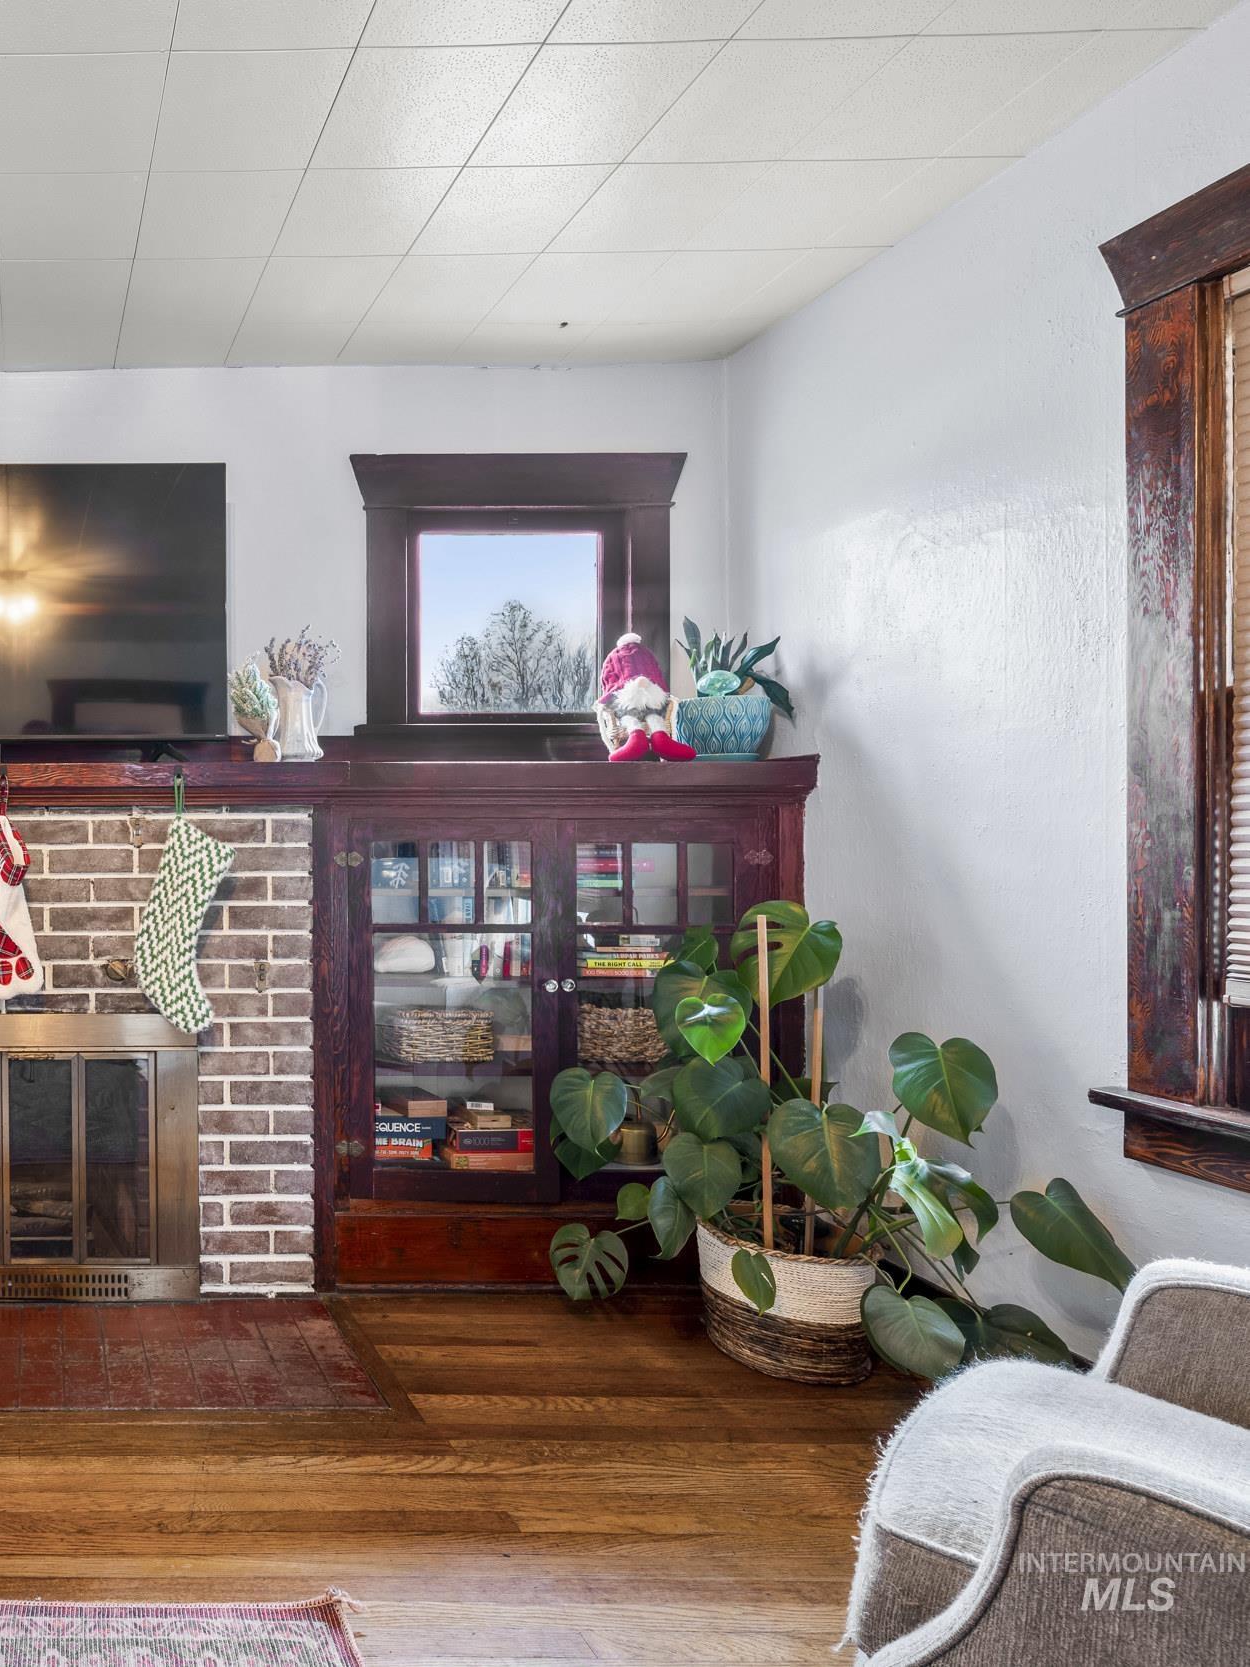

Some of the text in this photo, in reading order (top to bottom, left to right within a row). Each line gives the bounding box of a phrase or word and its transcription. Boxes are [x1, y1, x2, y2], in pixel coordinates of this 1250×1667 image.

[375, 1122, 421, 1133] EQUENCE
[375, 1137, 423, 1148] ME BRAIN
